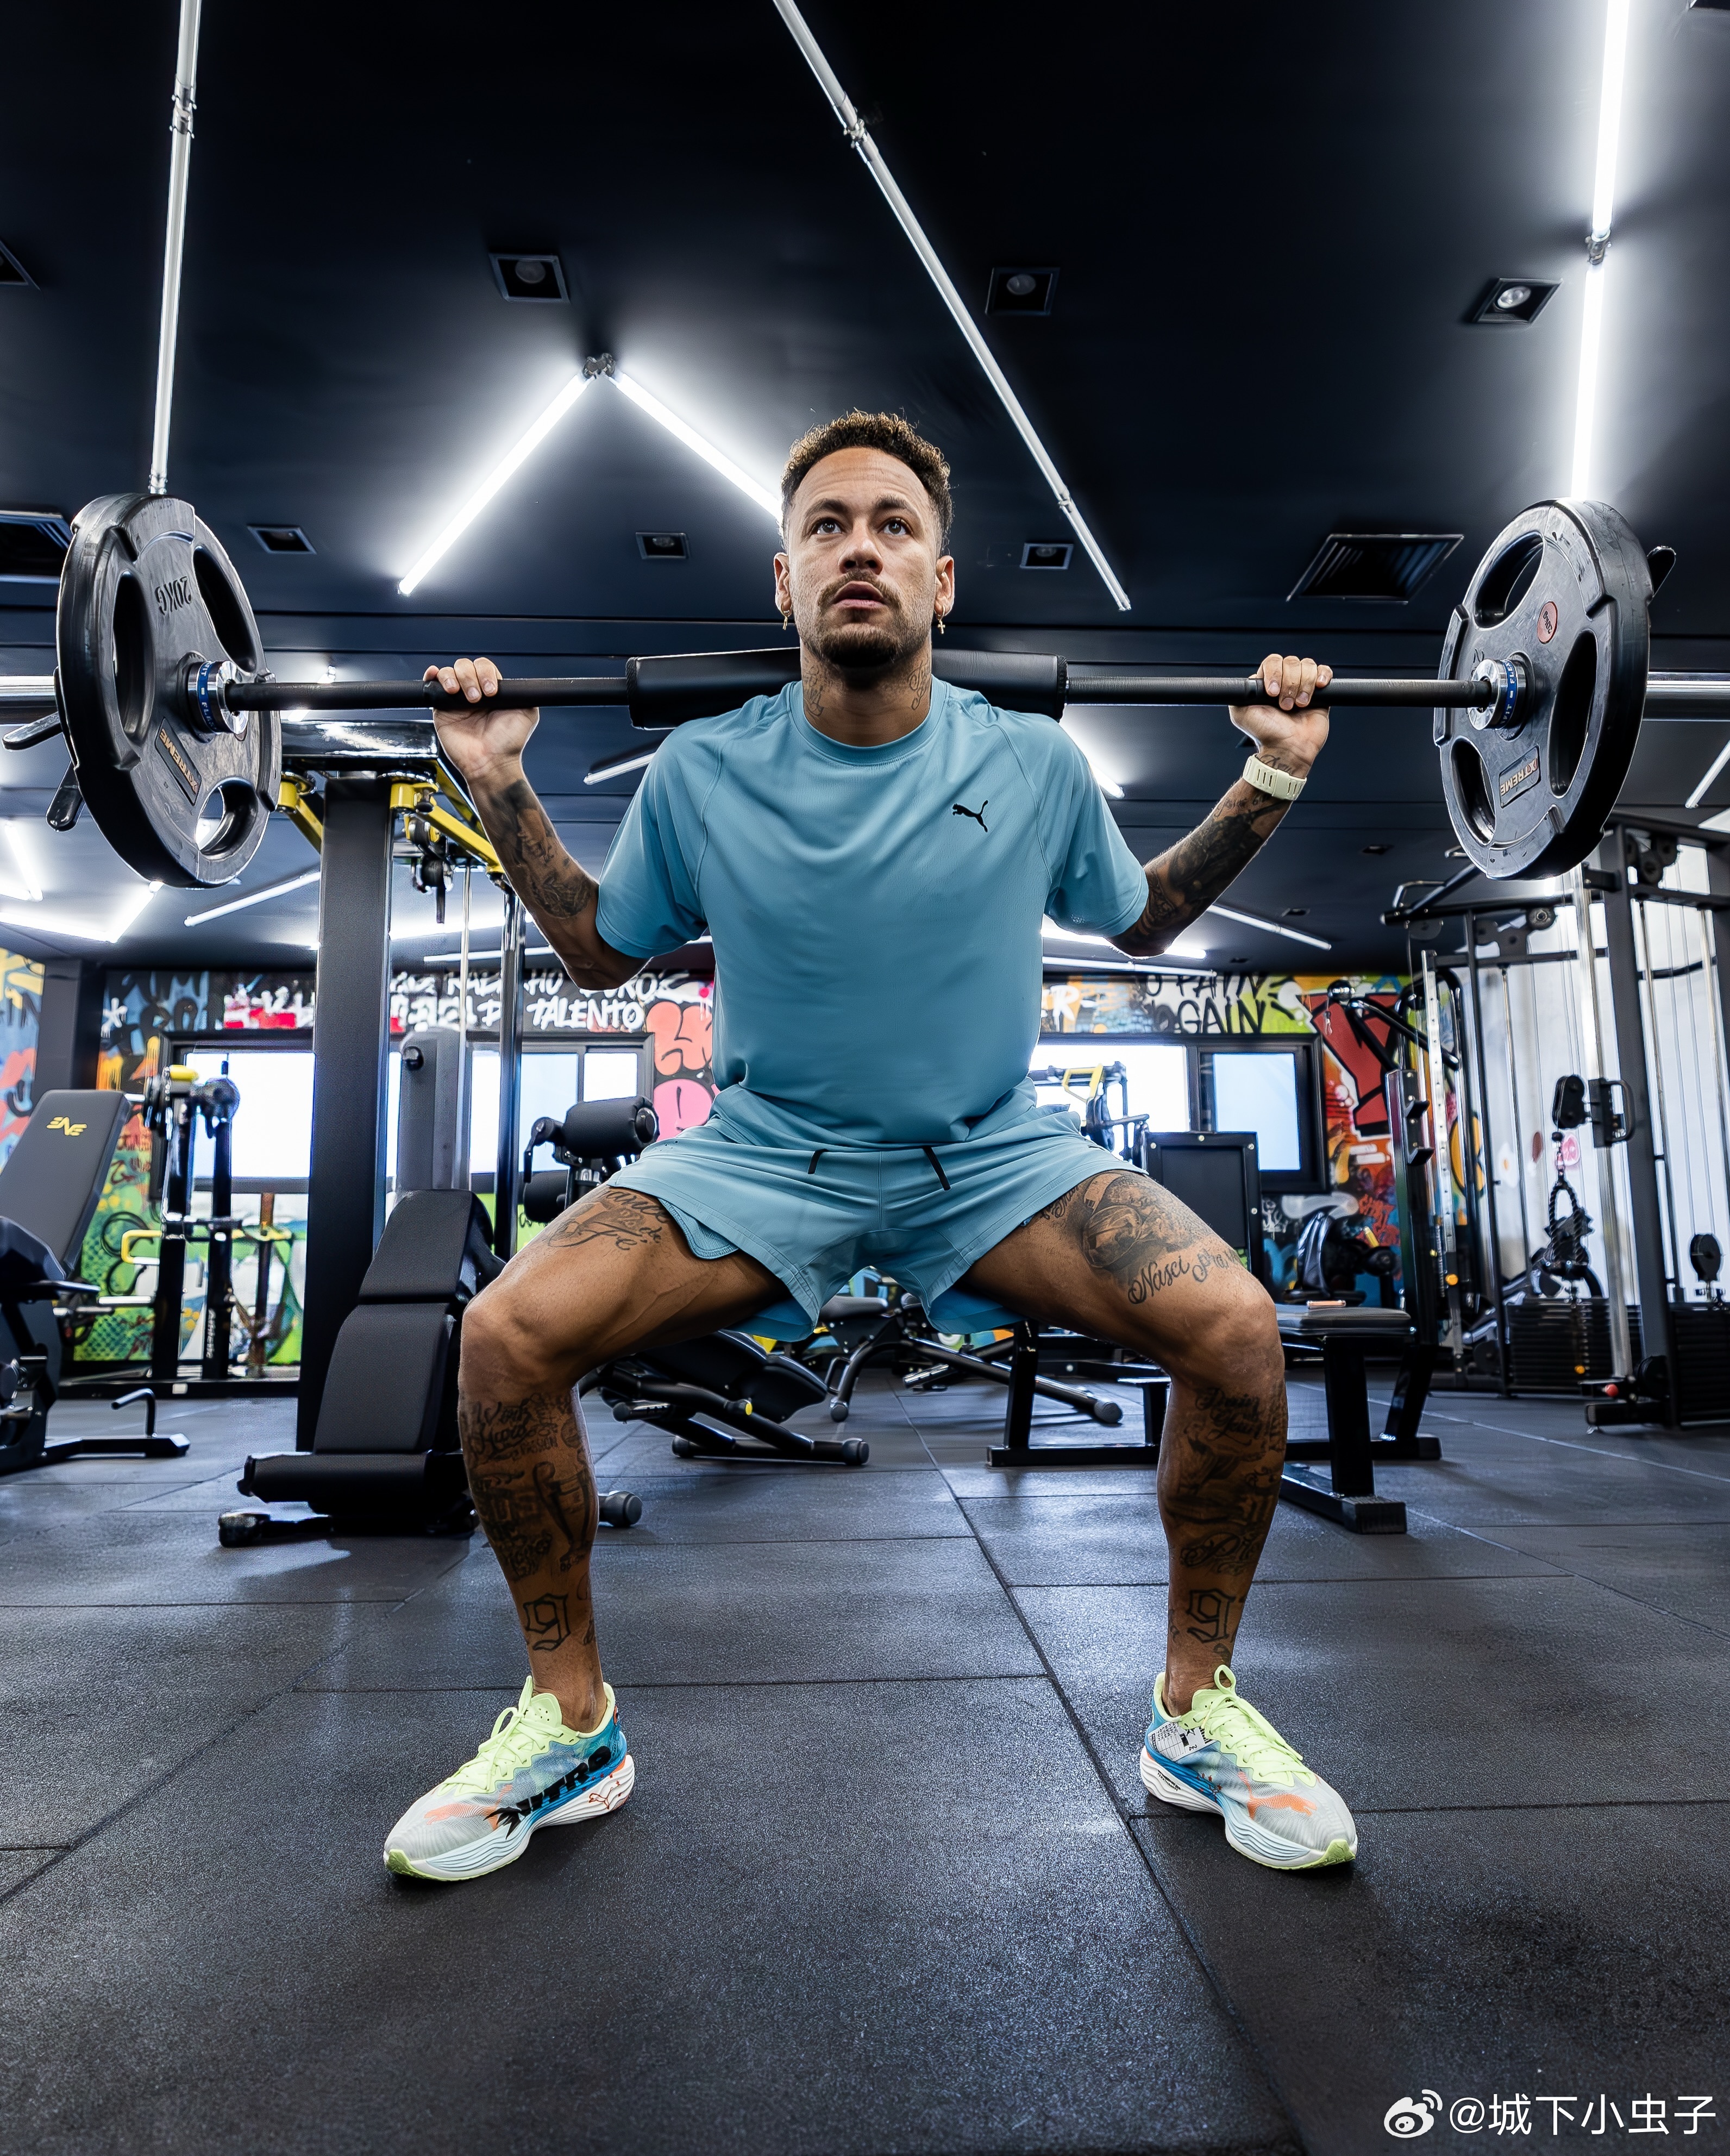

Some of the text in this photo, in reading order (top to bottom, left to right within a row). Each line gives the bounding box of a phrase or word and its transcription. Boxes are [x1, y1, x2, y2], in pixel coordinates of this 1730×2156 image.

[154, 576, 192, 616] 20KG
[526, 995, 645, 1030] TALENTO
[1177, 996, 1267, 1033] GAIN
[1128, 1256, 1190, 1304] Nasci
[483, 1745, 611, 1840] NITRO
